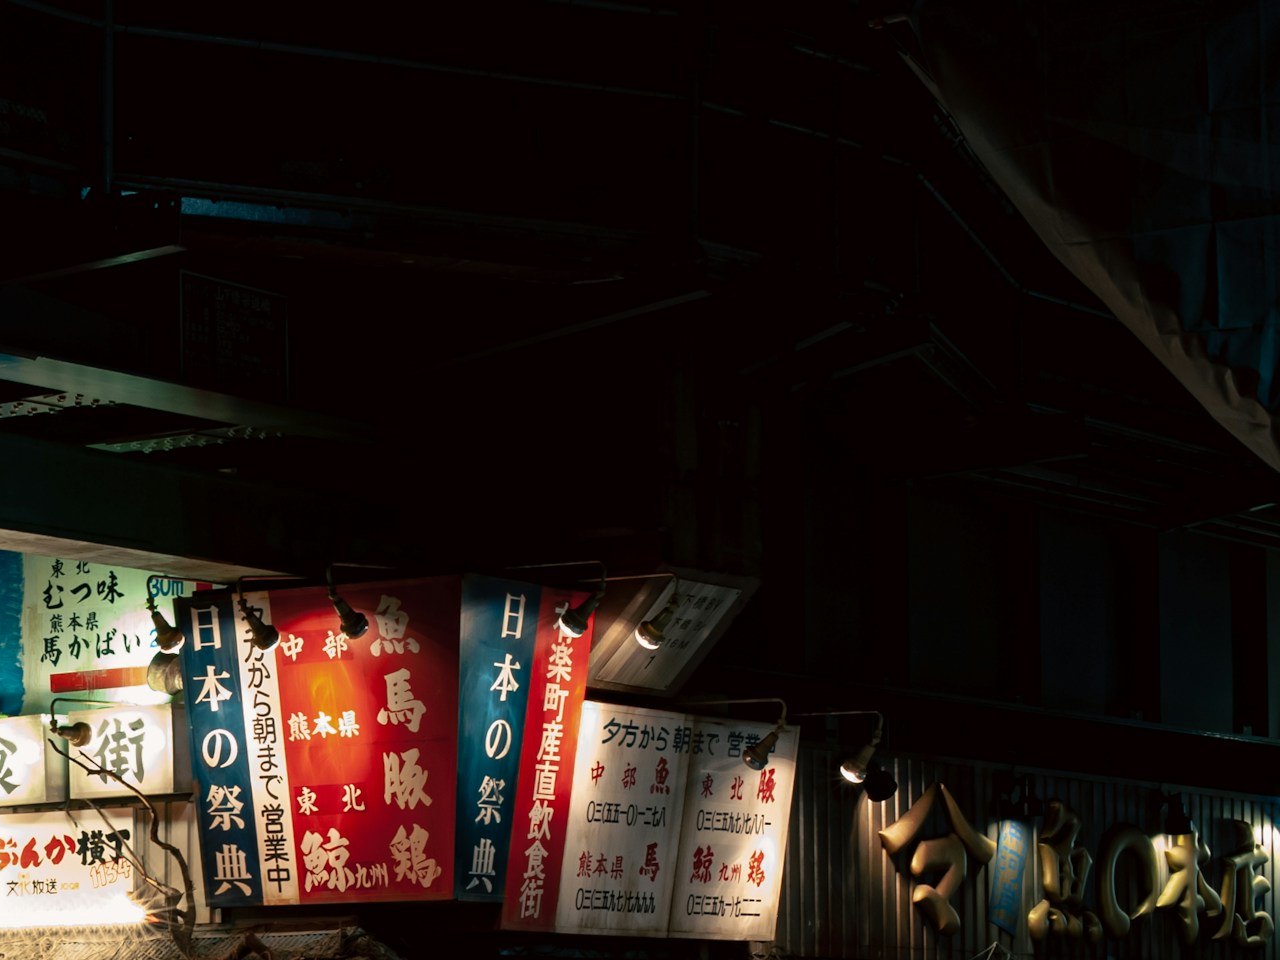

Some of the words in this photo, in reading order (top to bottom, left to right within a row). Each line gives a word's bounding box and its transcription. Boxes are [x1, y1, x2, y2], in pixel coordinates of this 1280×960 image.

[51, 558, 90, 579] 東北
[42, 570, 125, 610] むつ味
[50, 611, 100, 635] 熊本県
[370, 594, 421, 657] 魚
[41, 627, 141, 668] 馬かばい
[288, 710, 360, 743] 熊本県
[376, 667, 427, 733] 馬
[190, 605, 252, 896] 日本の祭典
[466, 592, 526, 893] 日本の祭典
[297, 784, 366, 816] 東北
[383, 748, 432, 810] 豚
[650, 756, 670, 795] 魚
[701, 773, 744, 801] 東北
[757, 768, 776, 804] 豚
[300, 828, 354, 893] 鯨
[355, 863, 389, 889] 九州
[389, 823, 442, 890] 鶏
[577, 850, 624, 880] 熊本県
[639, 842, 660, 883] 馬
[718, 862, 742, 884] 九州
[6, 878, 58, 897] 文化放送
